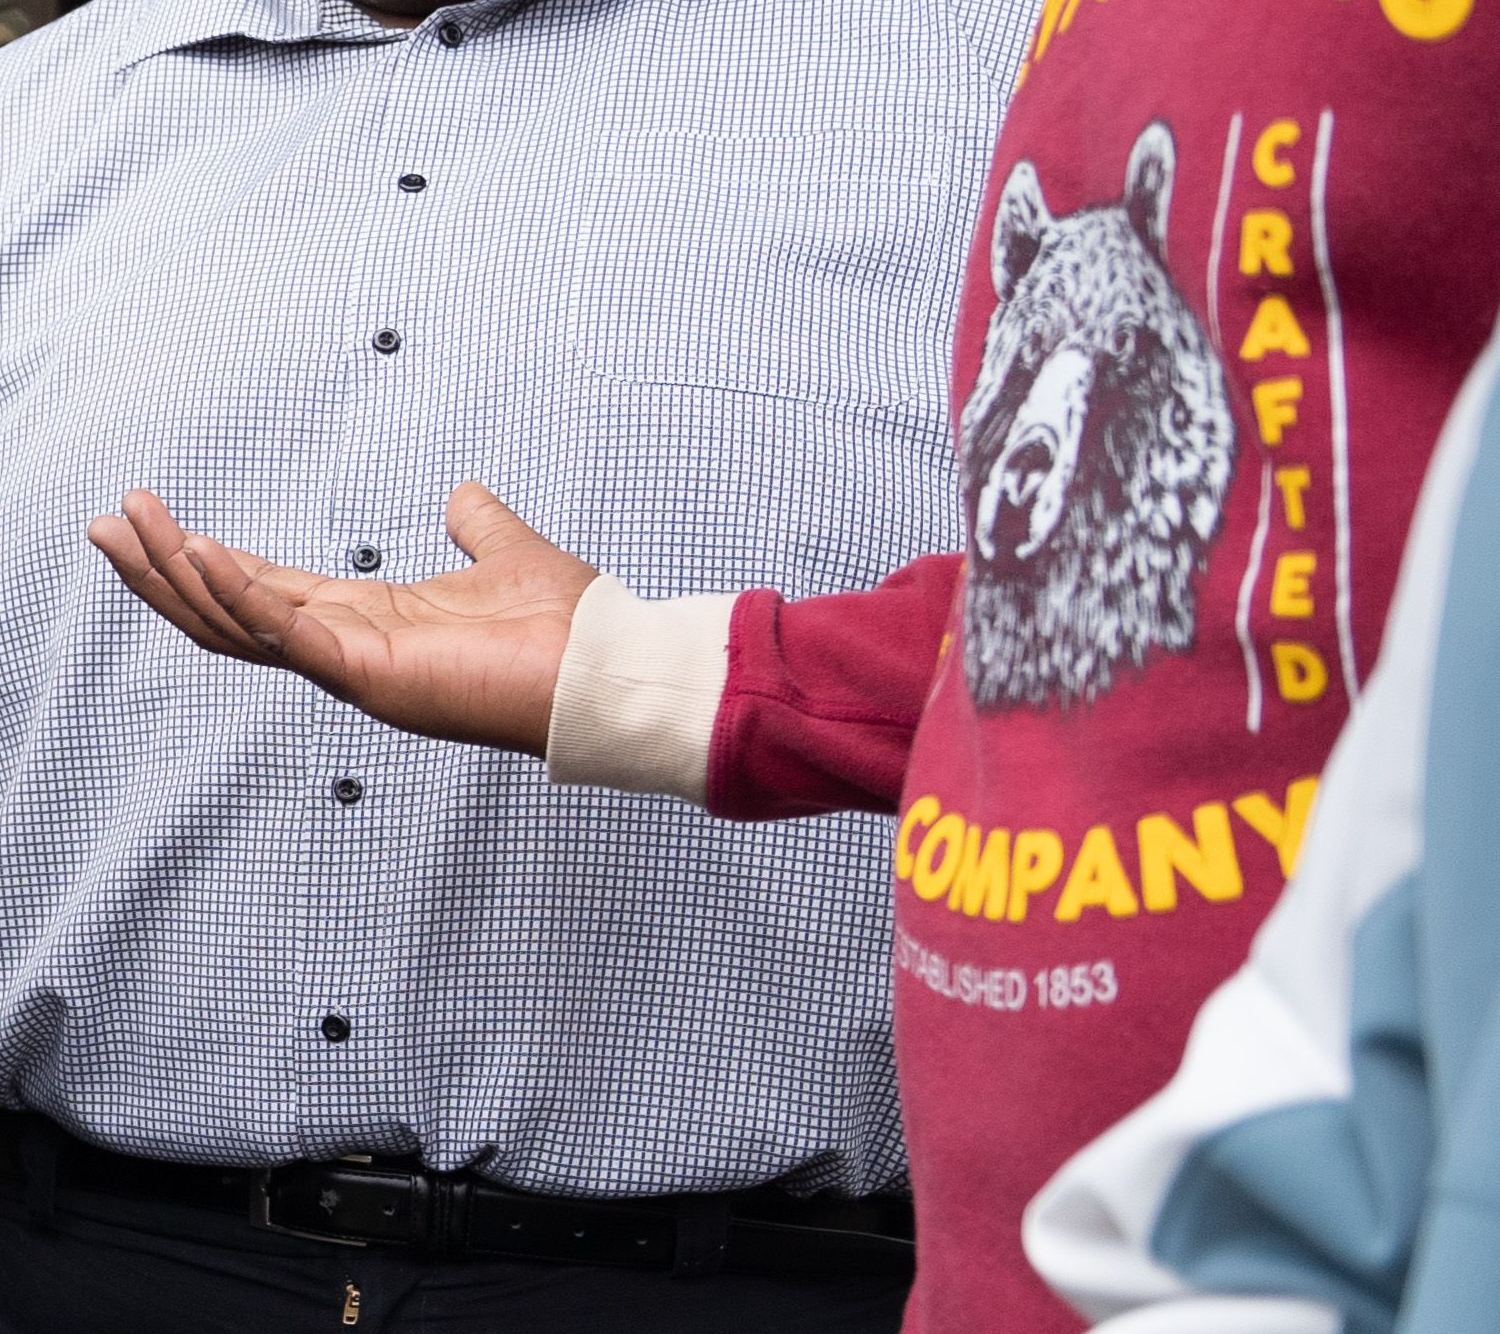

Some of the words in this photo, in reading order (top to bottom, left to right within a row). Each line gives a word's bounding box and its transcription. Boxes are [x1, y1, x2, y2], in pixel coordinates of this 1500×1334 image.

[1238, 119, 1331, 705] CRAFTED
[895, 775, 1322, 924] COMPANY
[896, 925, 1027, 1011] STABLISHED
[1032, 959, 1119, 1009] 1853
